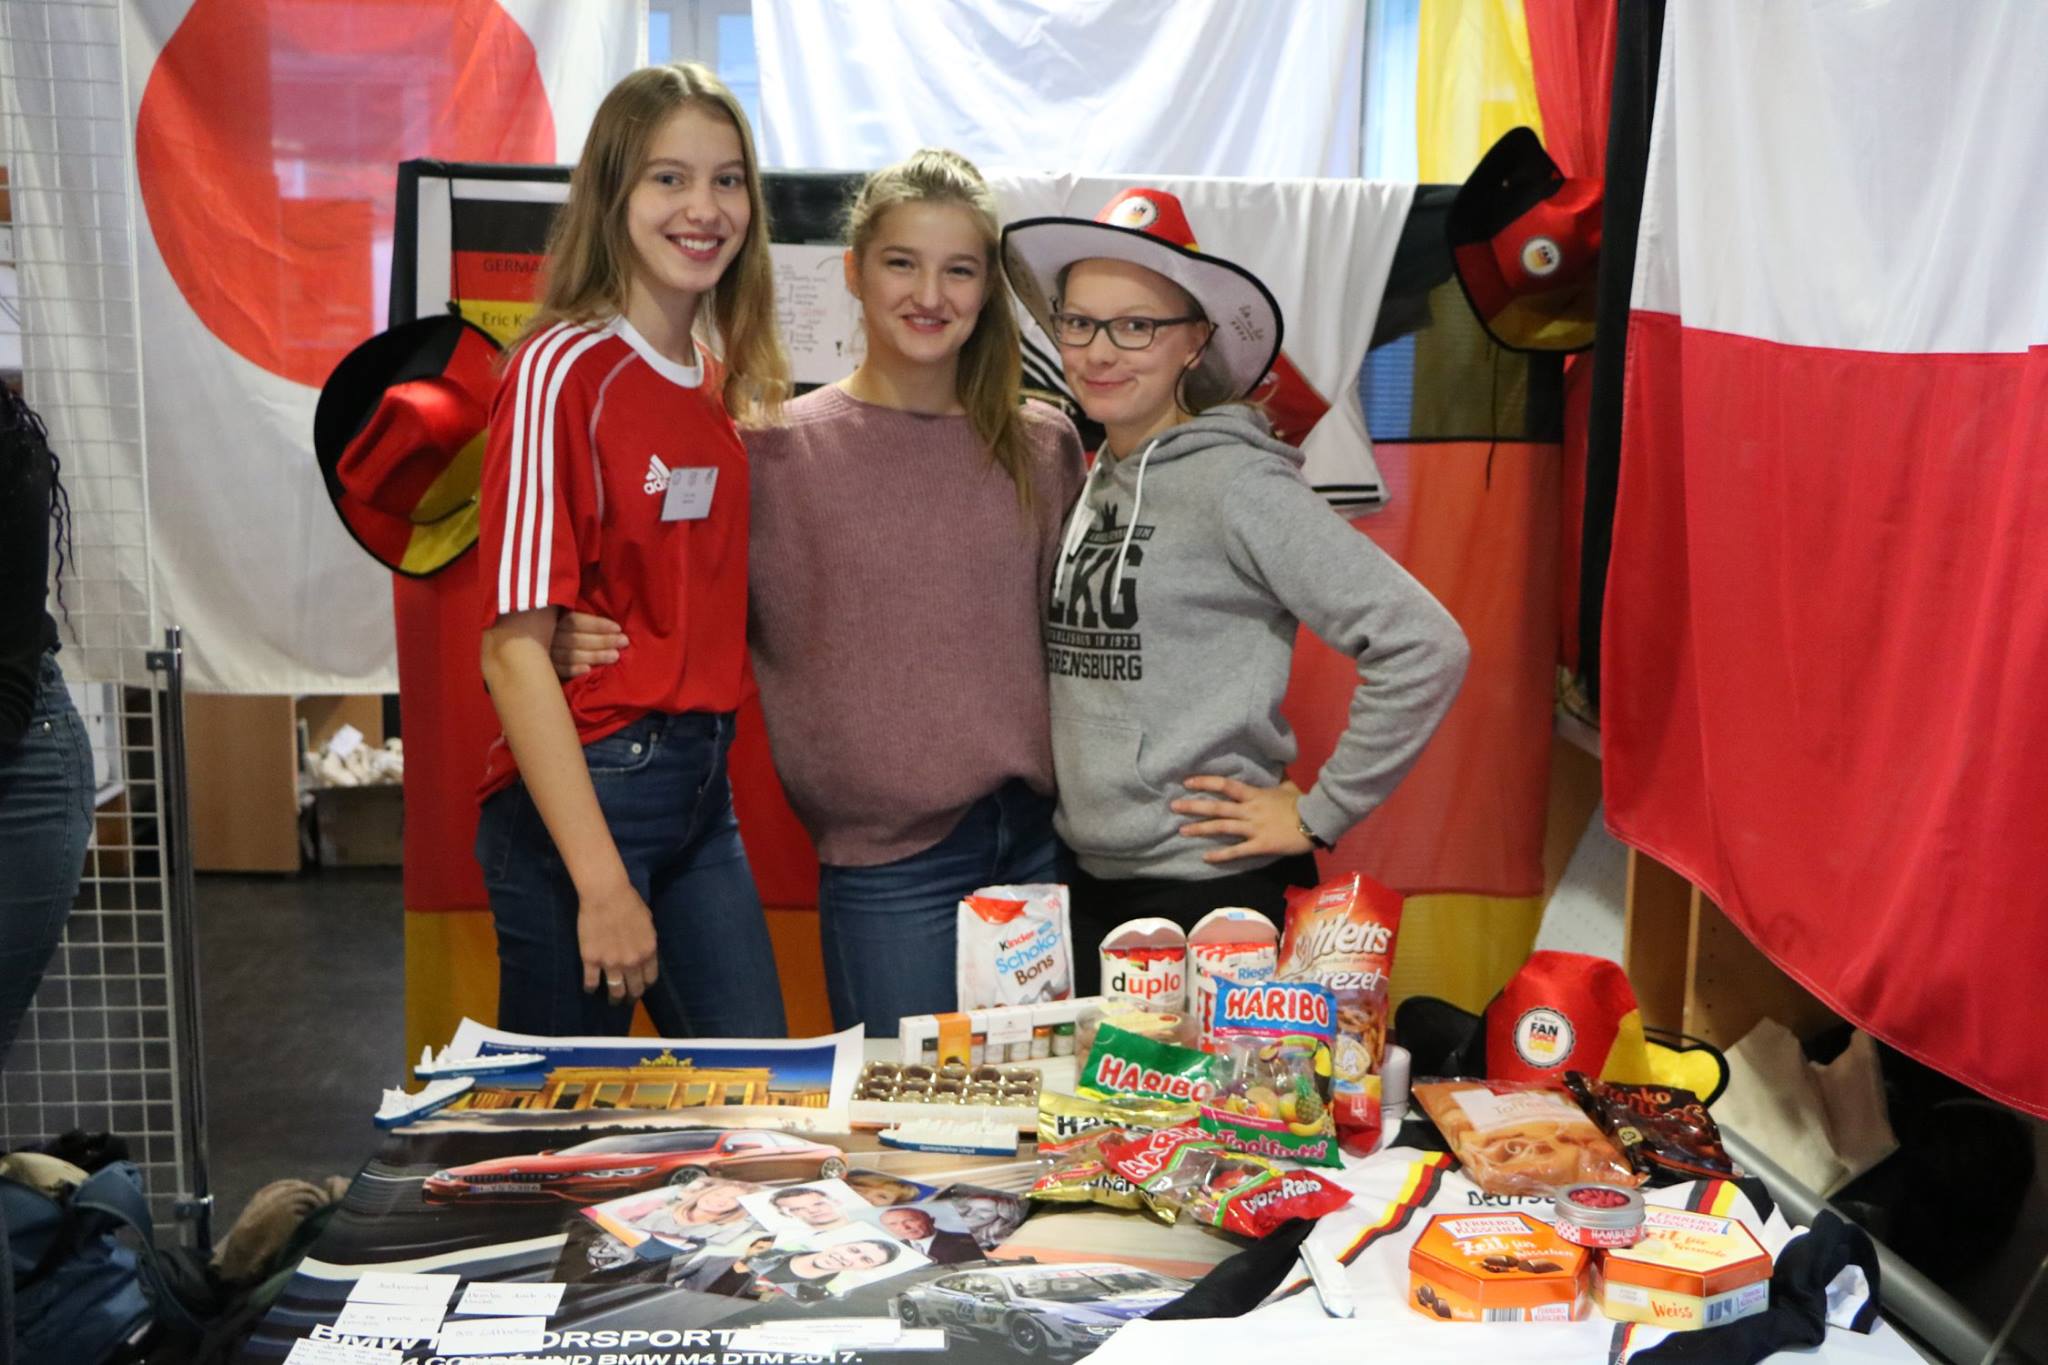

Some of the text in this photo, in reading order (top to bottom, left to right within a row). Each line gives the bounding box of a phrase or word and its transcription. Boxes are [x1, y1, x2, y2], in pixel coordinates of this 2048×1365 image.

[483, 259, 540, 272] GERMA
[1014, 954, 1054, 986] Bons
[1112, 971, 1181, 1000] duplo
[1225, 987, 1329, 1027] HARIBO
[1530, 1023, 1558, 1037] FAN
[1097, 1054, 1215, 1103] HARIBO
[1651, 1300, 1694, 1319] Weiss
[598, 1354, 672, 1365] BMW
[678, 1353, 717, 1365] M4
[722, 1353, 785, 1364] DTM
